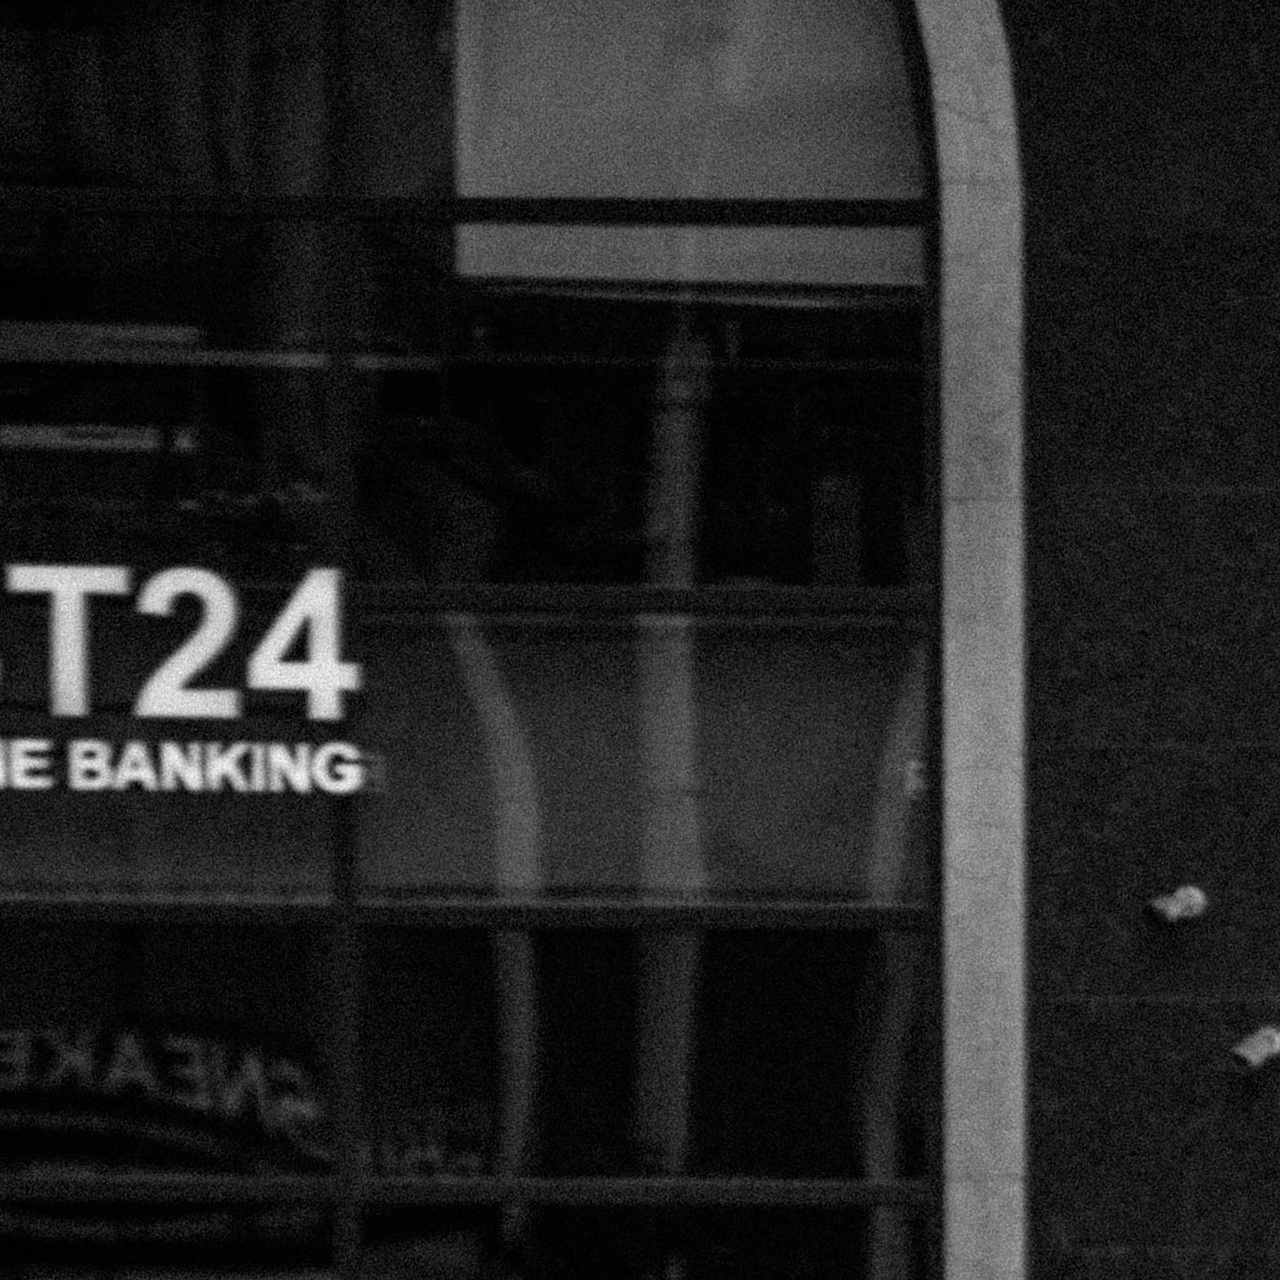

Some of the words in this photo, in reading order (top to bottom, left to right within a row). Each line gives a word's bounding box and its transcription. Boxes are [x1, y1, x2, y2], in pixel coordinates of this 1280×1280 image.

[0, 564, 362, 721] T24
[0, 738, 54, 790] E
[68, 738, 364, 794] BANKING
